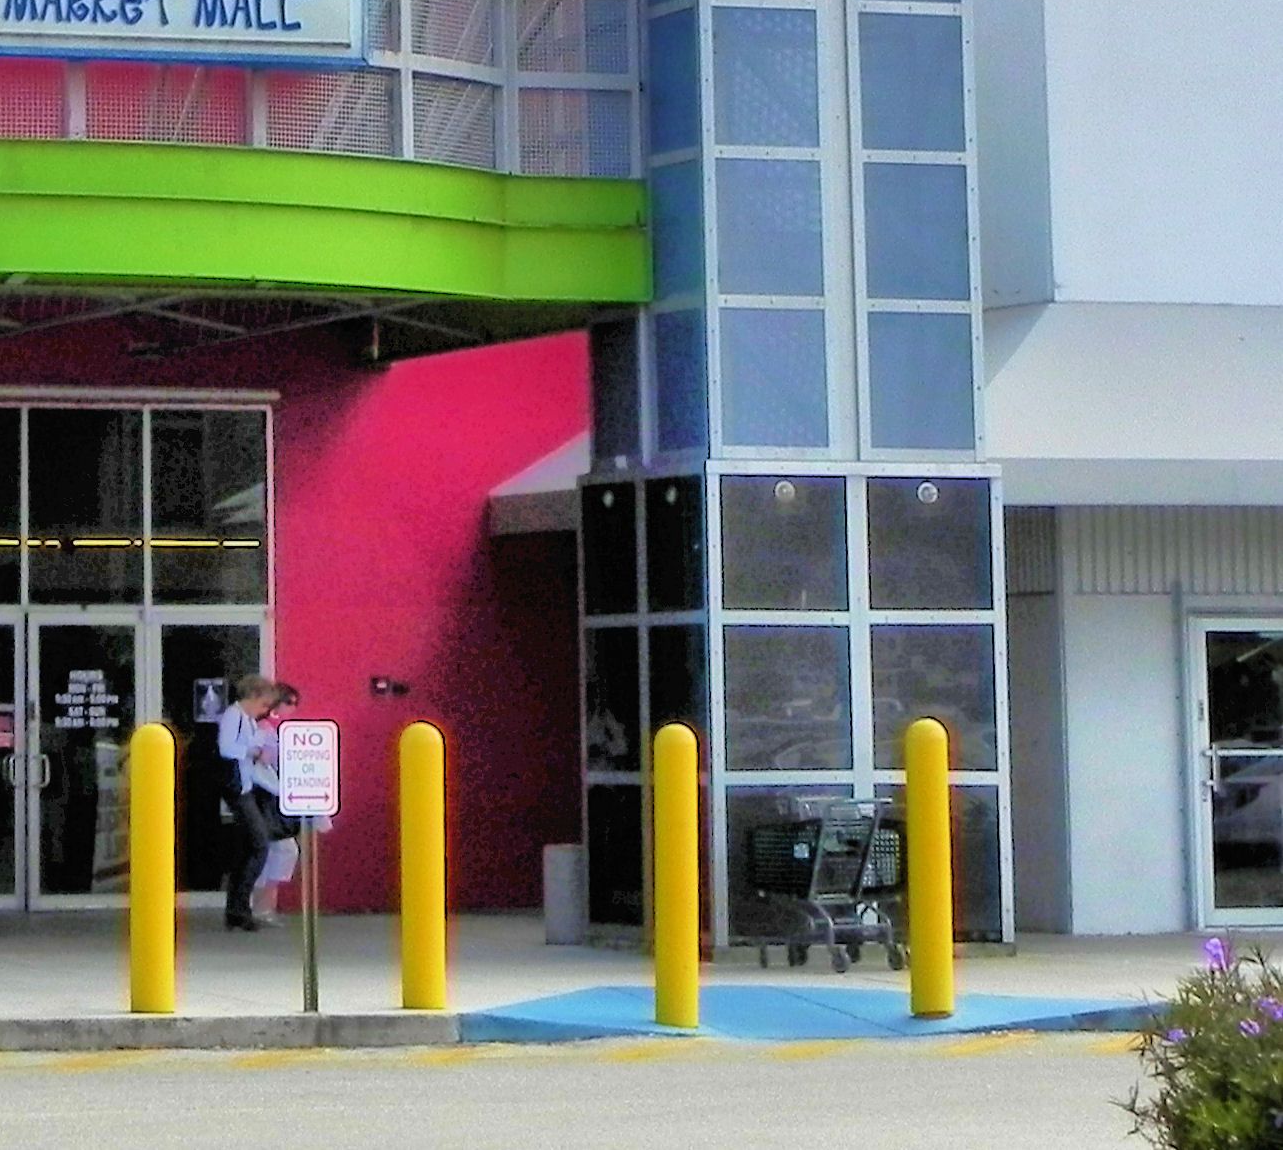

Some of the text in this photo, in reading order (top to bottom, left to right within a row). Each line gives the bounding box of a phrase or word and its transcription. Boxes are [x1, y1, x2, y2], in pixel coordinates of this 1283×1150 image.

[293, 733, 323, 746] NO
[286, 750, 330, 761] STOPPING
[301, 763, 316, 775] OR
[286, 777, 330, 788] STANDING
